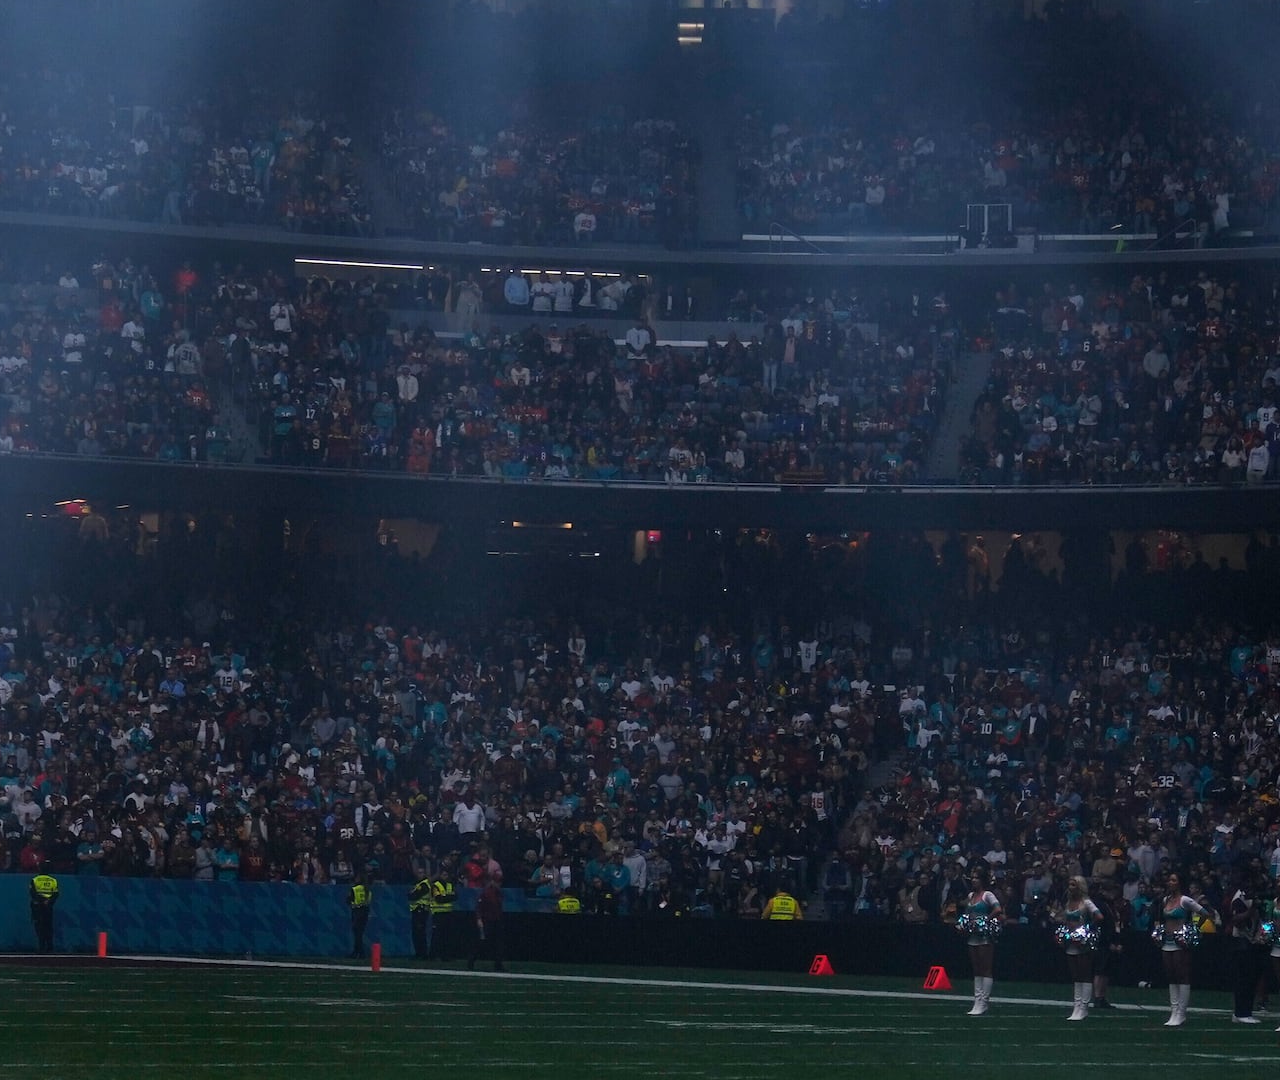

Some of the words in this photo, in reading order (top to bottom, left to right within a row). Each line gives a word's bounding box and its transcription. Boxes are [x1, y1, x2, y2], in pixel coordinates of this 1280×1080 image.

[1083, 341, 1090, 352] 6
[306, 409, 316, 419] 17
[981, 723, 992, 735] 10
[610, 737, 617, 749] 3
[819, 751, 825, 762] 1
[1159, 776, 1175, 788] 32
